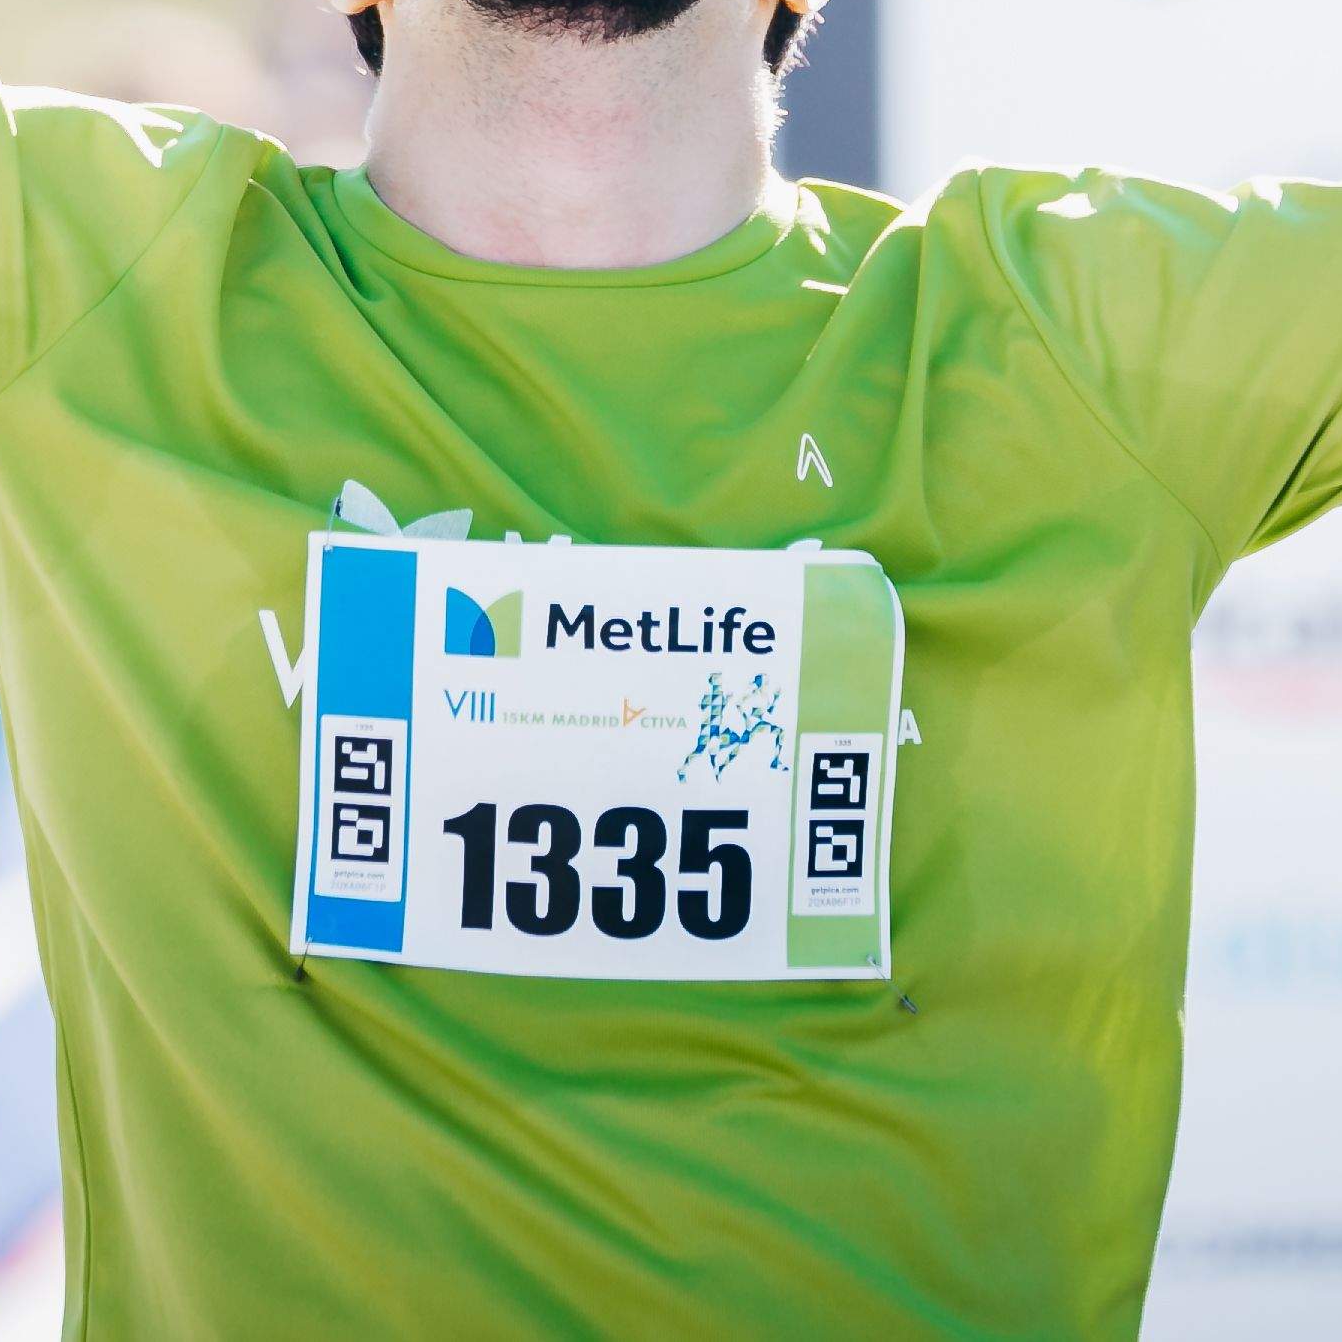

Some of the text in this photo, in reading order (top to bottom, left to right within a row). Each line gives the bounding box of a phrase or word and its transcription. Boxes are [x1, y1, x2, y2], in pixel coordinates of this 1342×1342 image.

[545, 603, 776, 655] MetLife
[443, 689, 496, 723] VIII
[502, 711, 545, 725] 15KM
[443, 802, 753, 940] 1335
